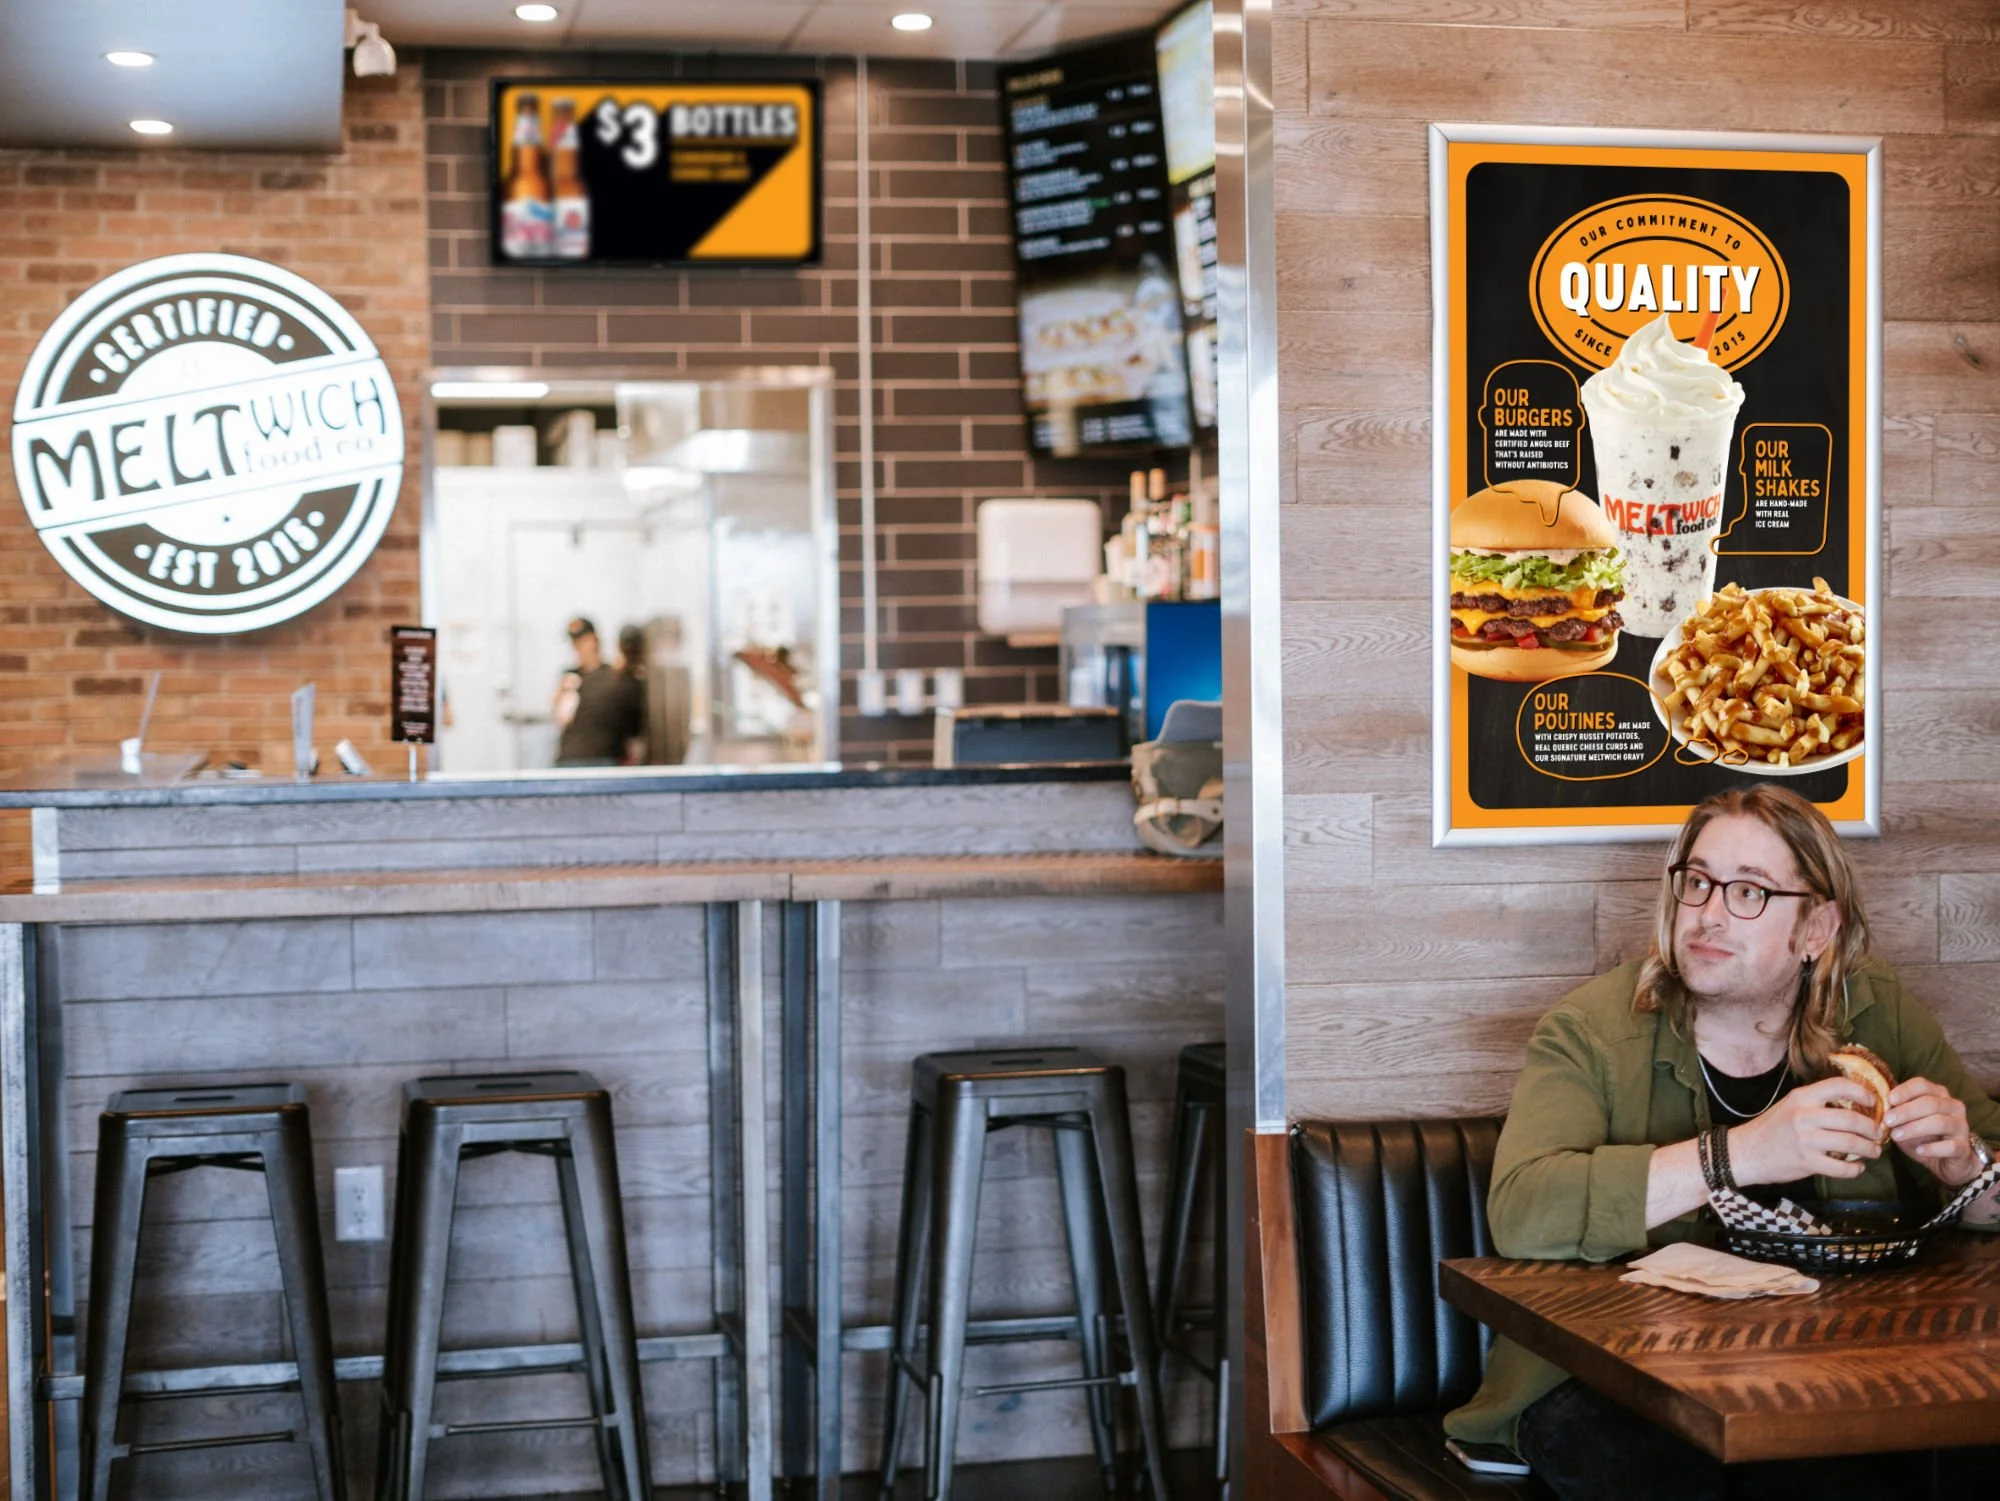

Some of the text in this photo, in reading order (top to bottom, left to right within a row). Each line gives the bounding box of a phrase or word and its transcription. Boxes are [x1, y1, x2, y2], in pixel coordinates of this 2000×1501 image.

[670, 104, 797, 136] BOTTLES
[596, 98, 659, 168] $3
[1580, 214, 1741, 250] OUR COMMITMENT TO
[1559, 261, 1761, 318] QUALITY
[92, 298, 281, 375] CERTIFIED
[1575, 328, 1746, 357] SINCE 2015
[1495, 388, 1529, 407] OUR
[1494, 408, 1573, 427] BURGERS
[1495, 429, 1547, 437] ARE MADE WITH
[29, 377, 386, 511] MELTWICH
[1495, 440, 1528, 448] CERTIFIED
[1755, 440, 1789, 458] OUR
[1495, 451, 1544, 459] THAT'S RAISED
[1495, 461, 1569, 469] WITHOUT ANTIBIOTICS
[1755, 460, 1792, 477] MILK
[1755, 480, 1820, 497] SHAKES
[1769, 500, 1808, 508] HAND-MADE
[1604, 493, 1721, 536] MELTWICH
[1675, 520, 1705, 535] food
[148, 517, 320, 589] EST 2015
[1534, 692, 1569, 710] OUR
[1534, 712, 1616, 730] POUTINES
[1535, 733, 1552, 741] WITH
[1553, 733, 1577, 741] CRISPY
[1606, 732, 1641, 740] POTATOES,
[1535, 743, 1551, 751] REAL
[1552, 743, 1578, 752] QUEBEC
[1550, 754, 1587, 762] SIGNATURE
[1588, 753, 1622, 761] MELTWICH
